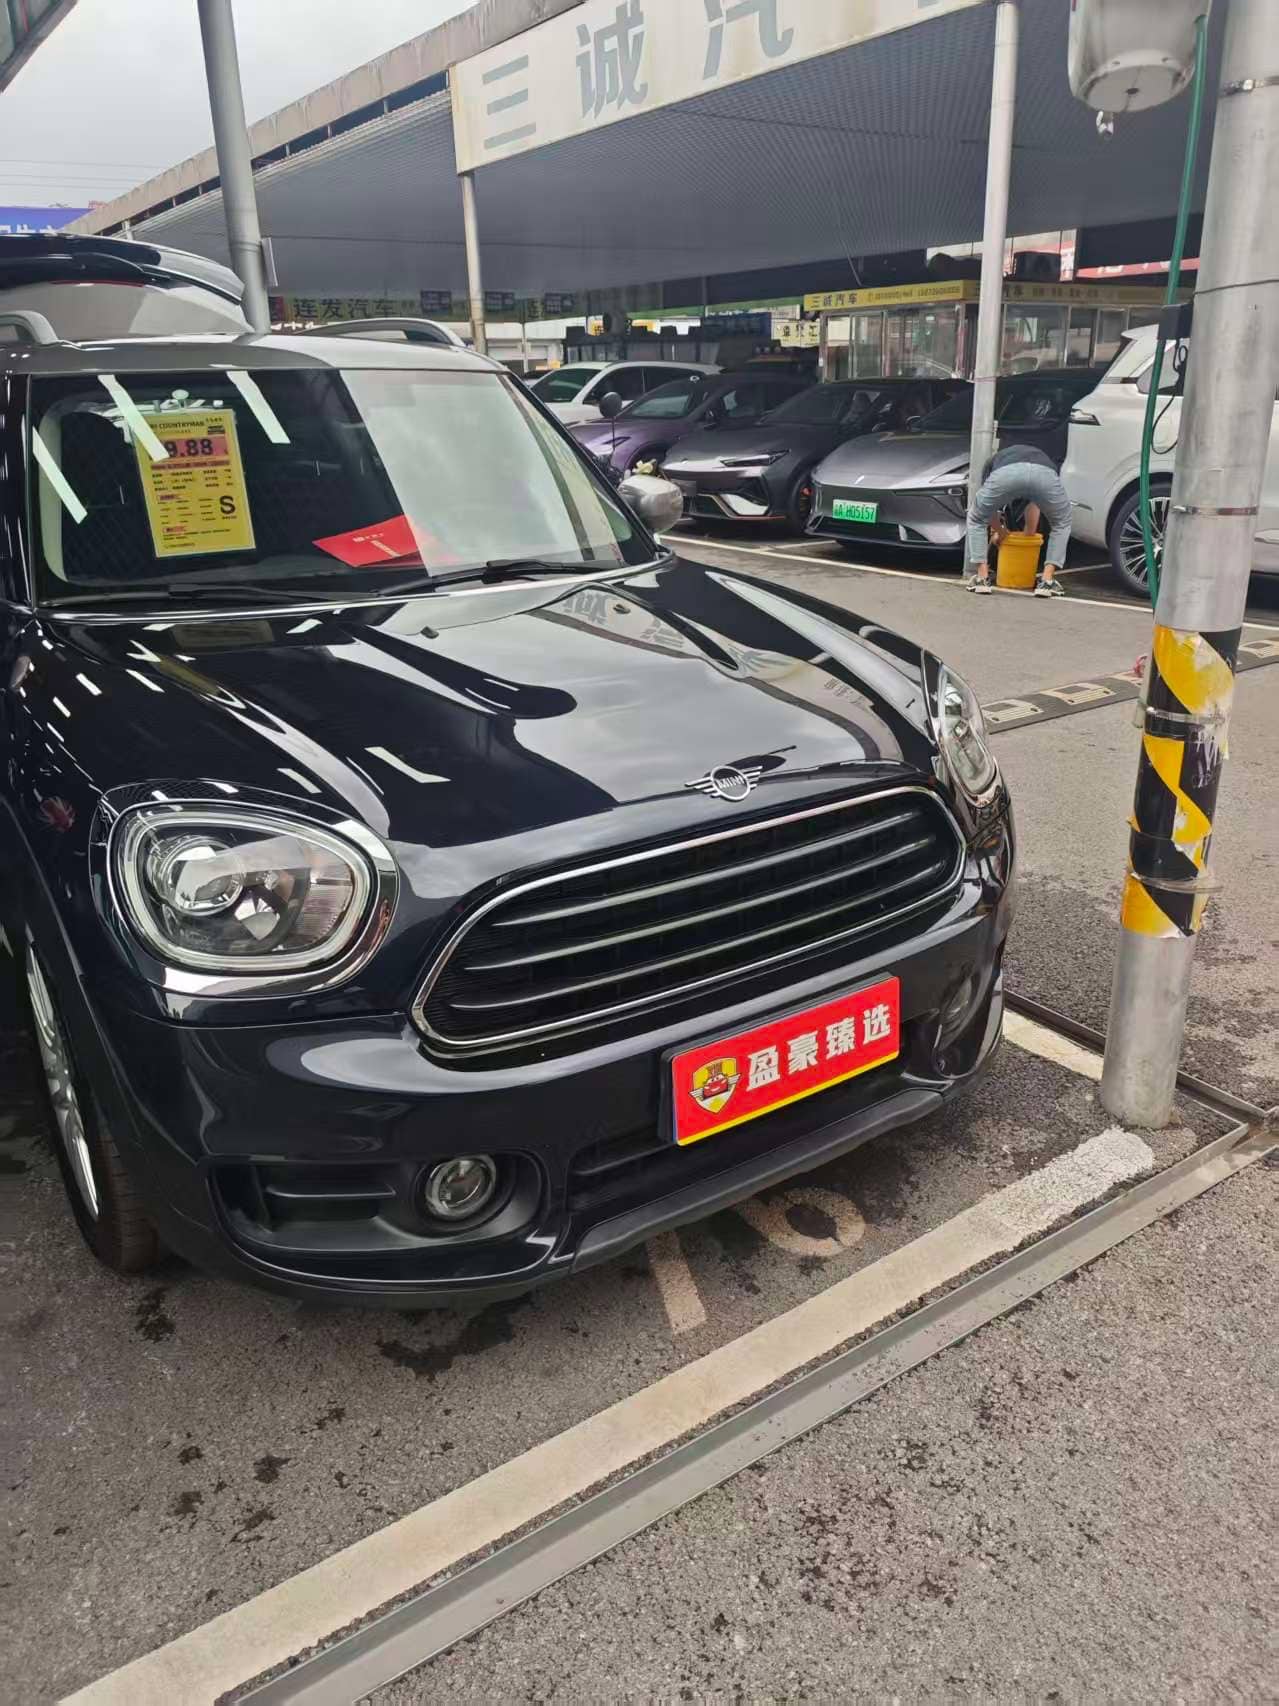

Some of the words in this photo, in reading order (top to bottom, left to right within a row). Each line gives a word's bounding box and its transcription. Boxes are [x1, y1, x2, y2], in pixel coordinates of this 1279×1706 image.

[482, 0, 940, 150] 三诚汽
[219, 495, 236, 515] S
[717, 775, 745, 789] MINI
[745, 1002, 891, 1092] 盈豪臻选
